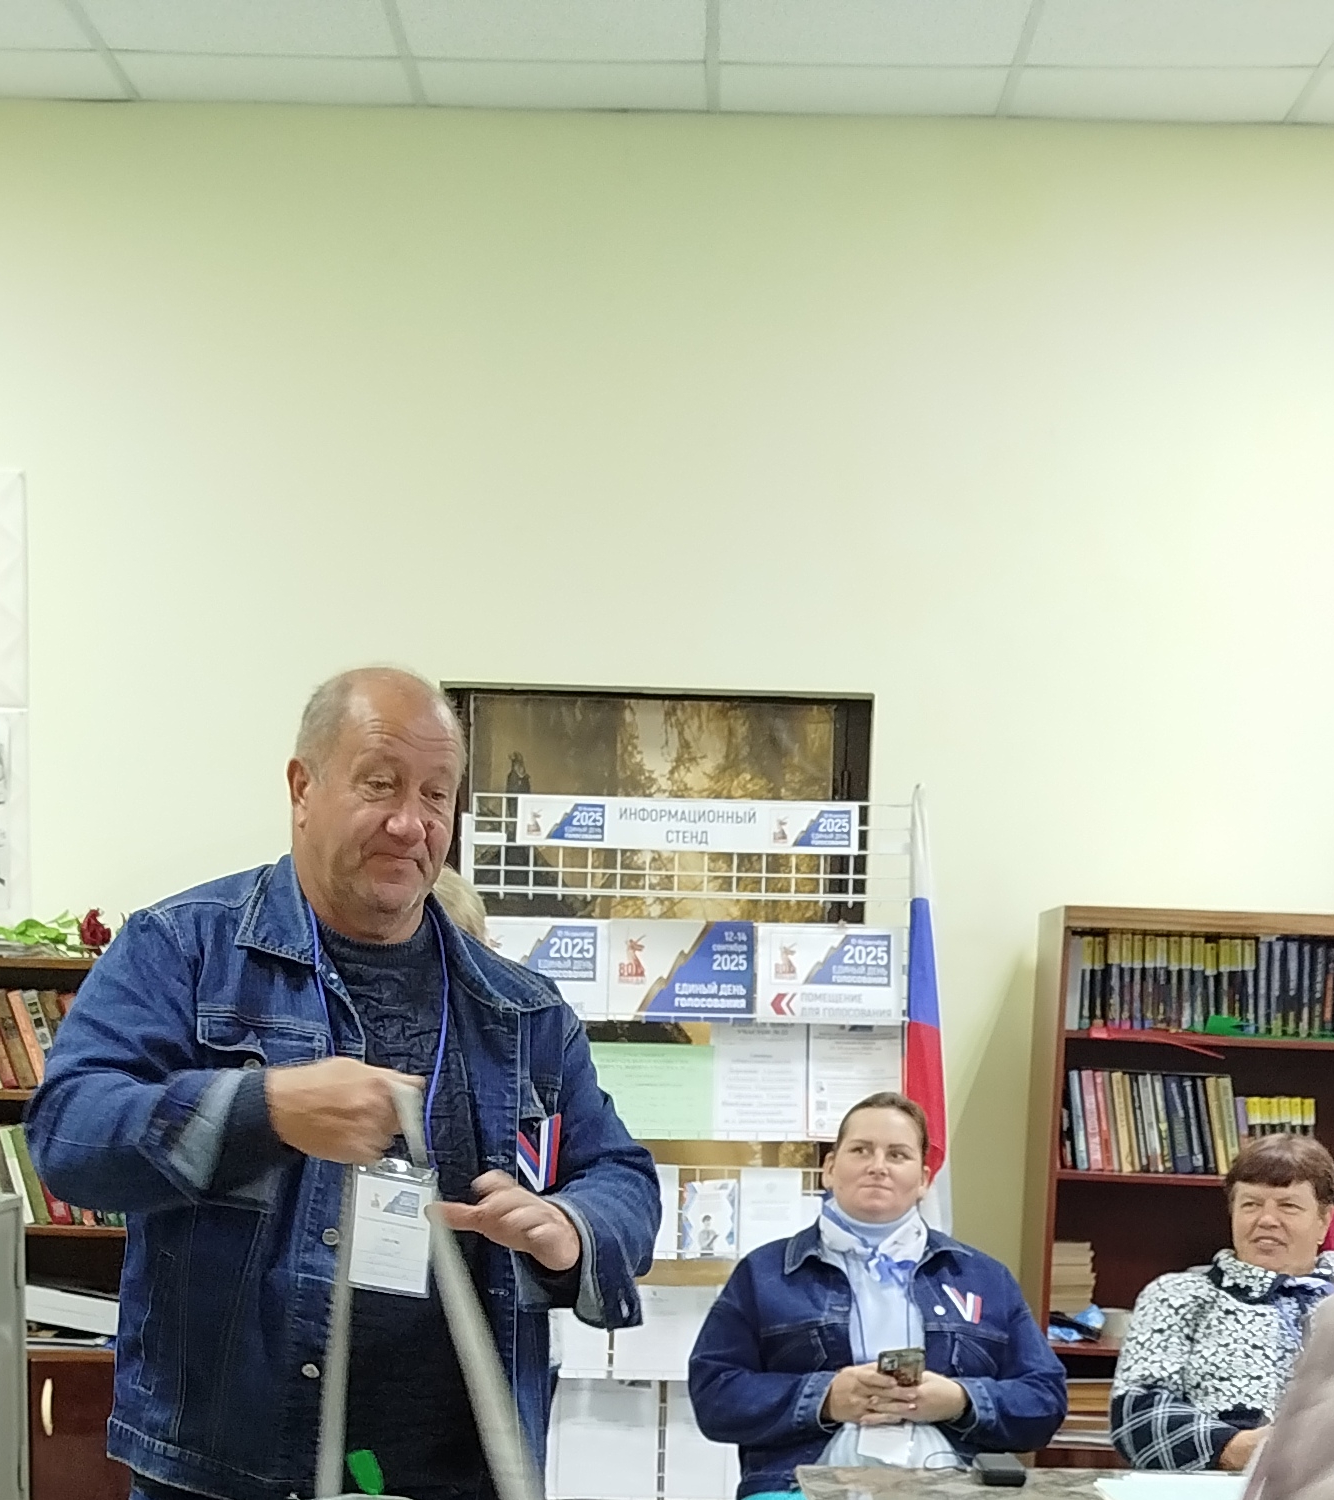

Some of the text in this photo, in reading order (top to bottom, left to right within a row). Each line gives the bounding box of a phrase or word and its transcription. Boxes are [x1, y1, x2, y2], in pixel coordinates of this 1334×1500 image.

[572, 811, 603, 826] 2025
[619, 806, 757, 825] ИНФОРМАЦИОННЫЙ
[819, 818, 849, 832] 2025
[666, 829, 708, 845] СТЕНД
[724, 931, 747, 941] 12-14
[549, 938, 594, 958] 2025
[843, 945, 888, 965] 2025
[712, 954, 747, 971] 2025
[675, 981, 746, 996] ЕДИНЫЙ ДЕНЬ
[674, 997, 746, 1009] ГОЛОСОВАНИЯ
